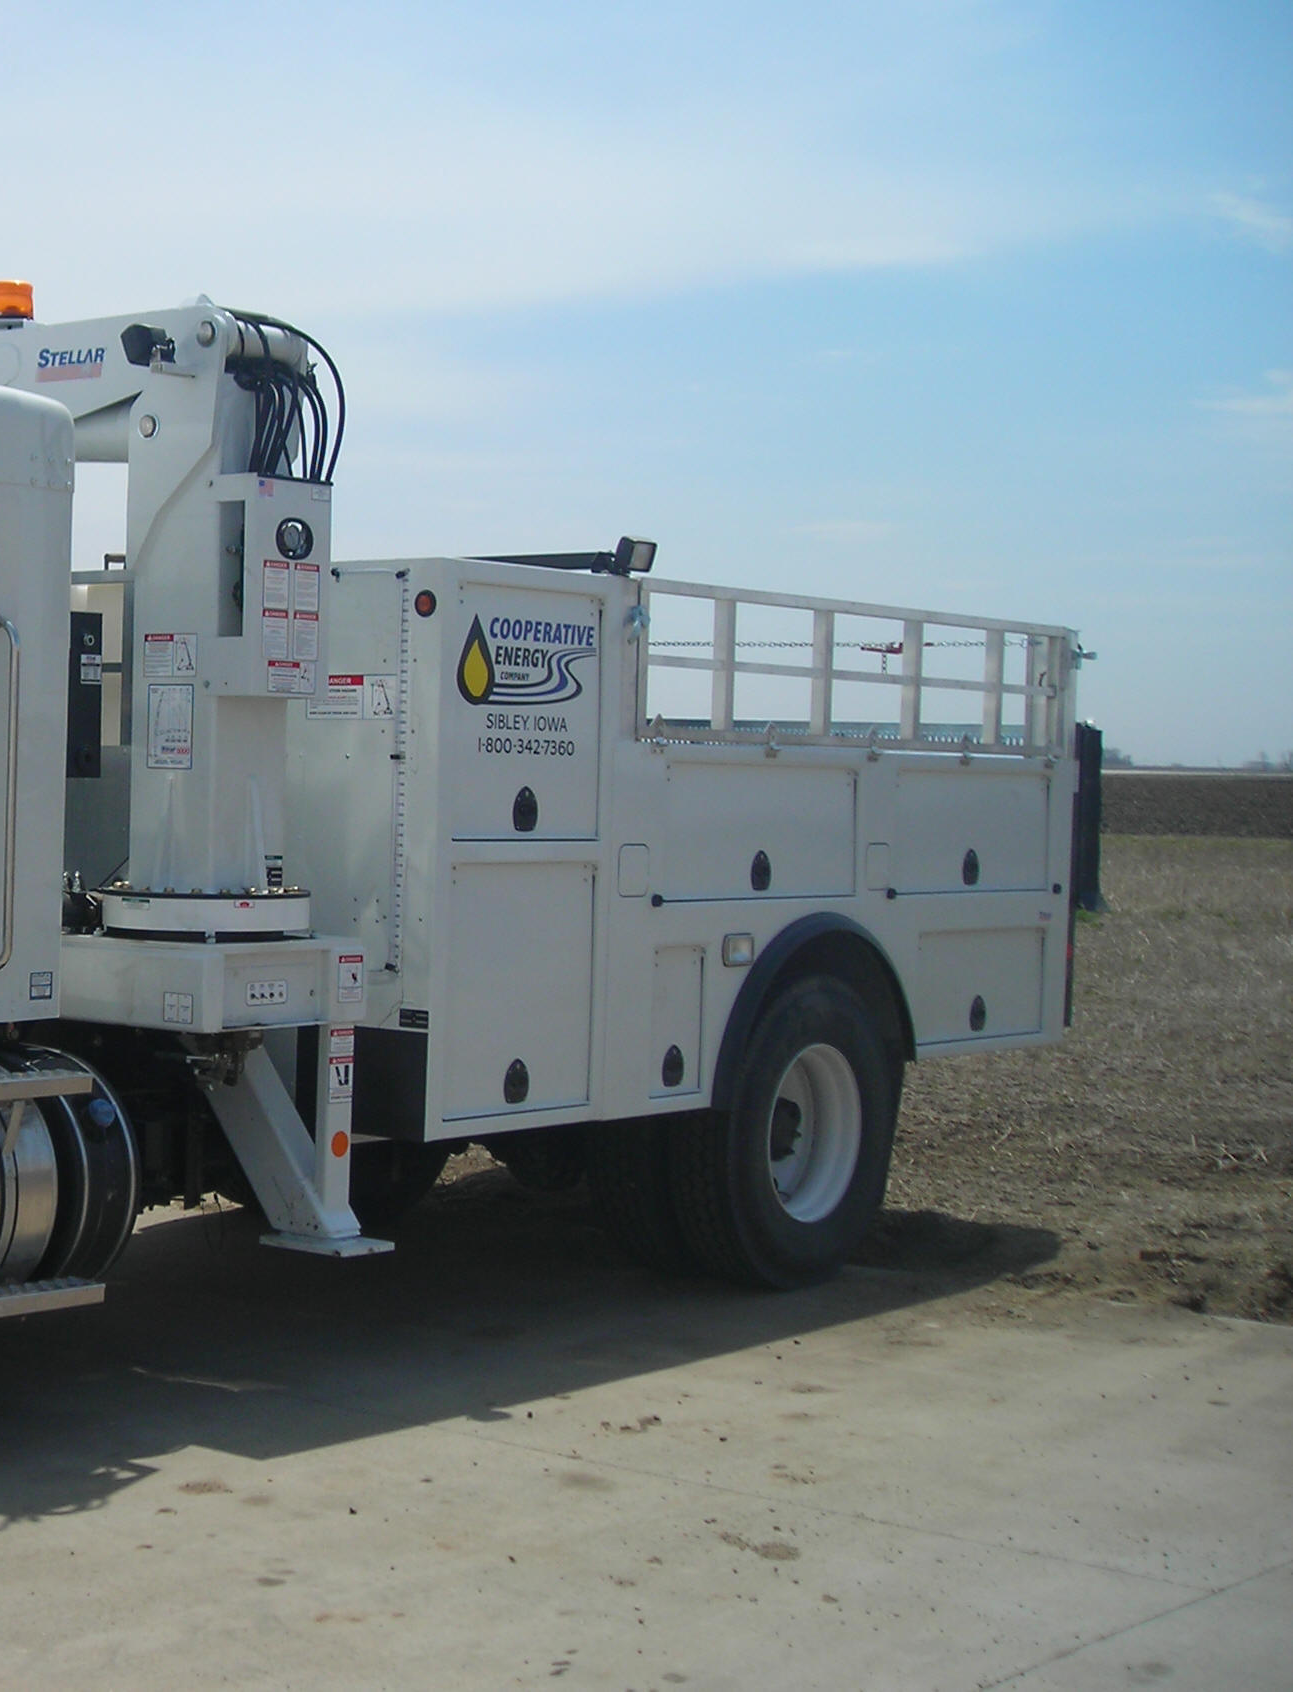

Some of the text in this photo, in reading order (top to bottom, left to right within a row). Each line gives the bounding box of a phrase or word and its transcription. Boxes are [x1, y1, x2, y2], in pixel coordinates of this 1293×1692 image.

[37, 347, 105, 368] STELLAR
[489, 617, 594, 646] COOPERATIVE
[494, 645, 548, 668] ENERGY
[329, 677, 352, 685] ANGER
[500, 671, 530, 681] COMPANY
[533, 716, 568, 732] IOWA
[478, 737, 575, 756] 1-800-342-7360
